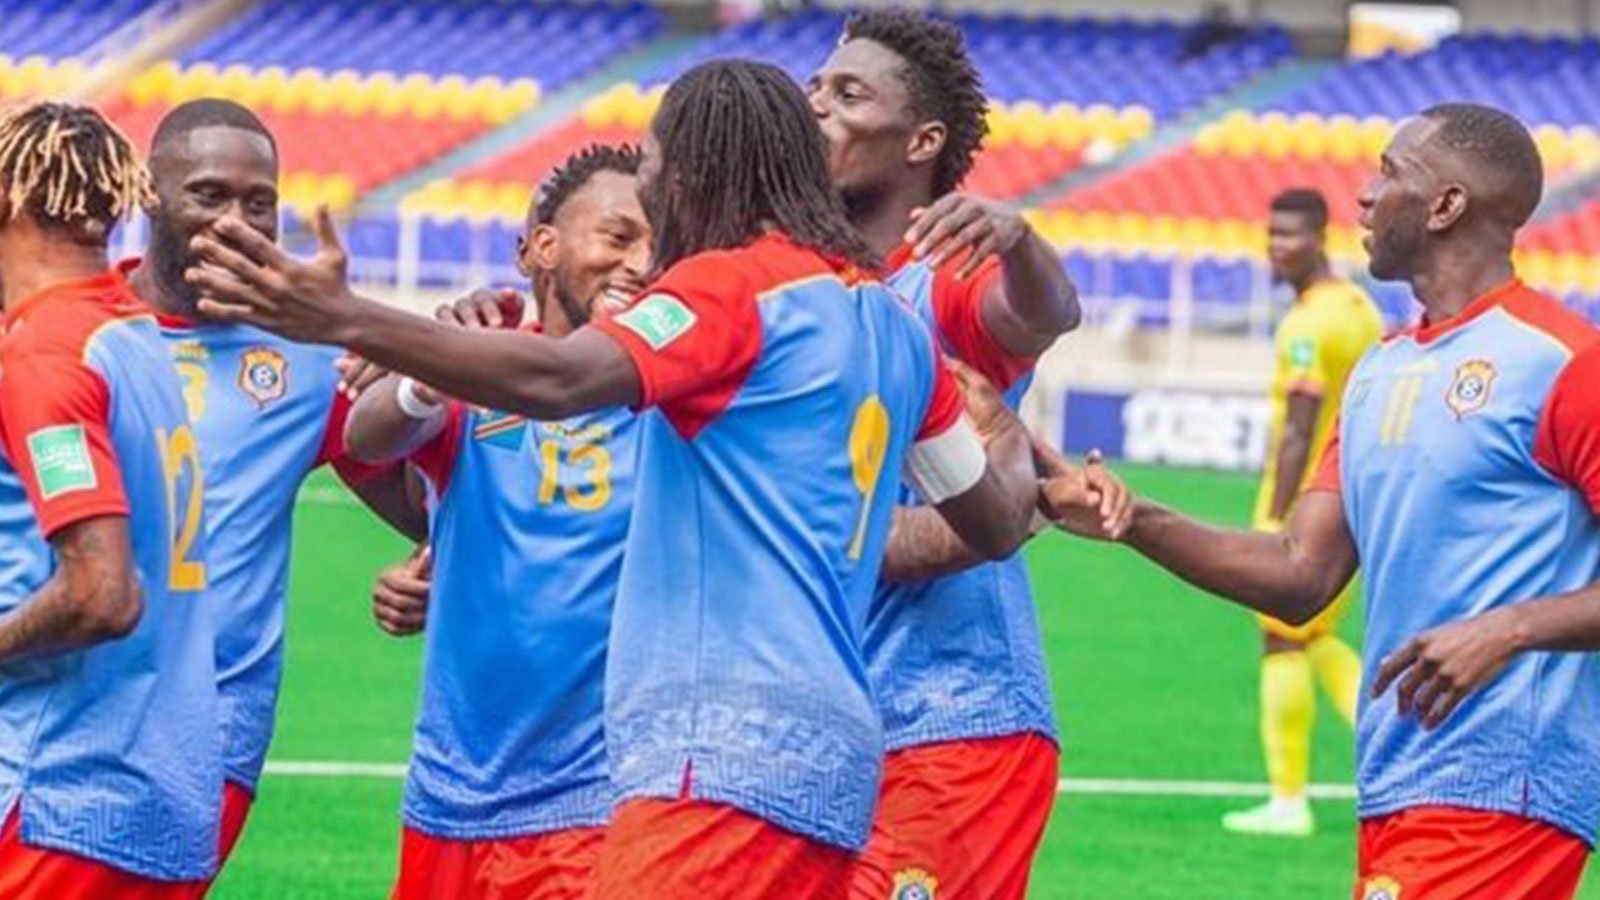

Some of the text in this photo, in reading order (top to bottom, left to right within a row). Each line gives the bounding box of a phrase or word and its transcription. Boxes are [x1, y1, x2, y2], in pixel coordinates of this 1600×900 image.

[1379, 377, 1425, 447] 11
[538, 440, 612, 511] 13
[849, 396, 891, 560] 9
